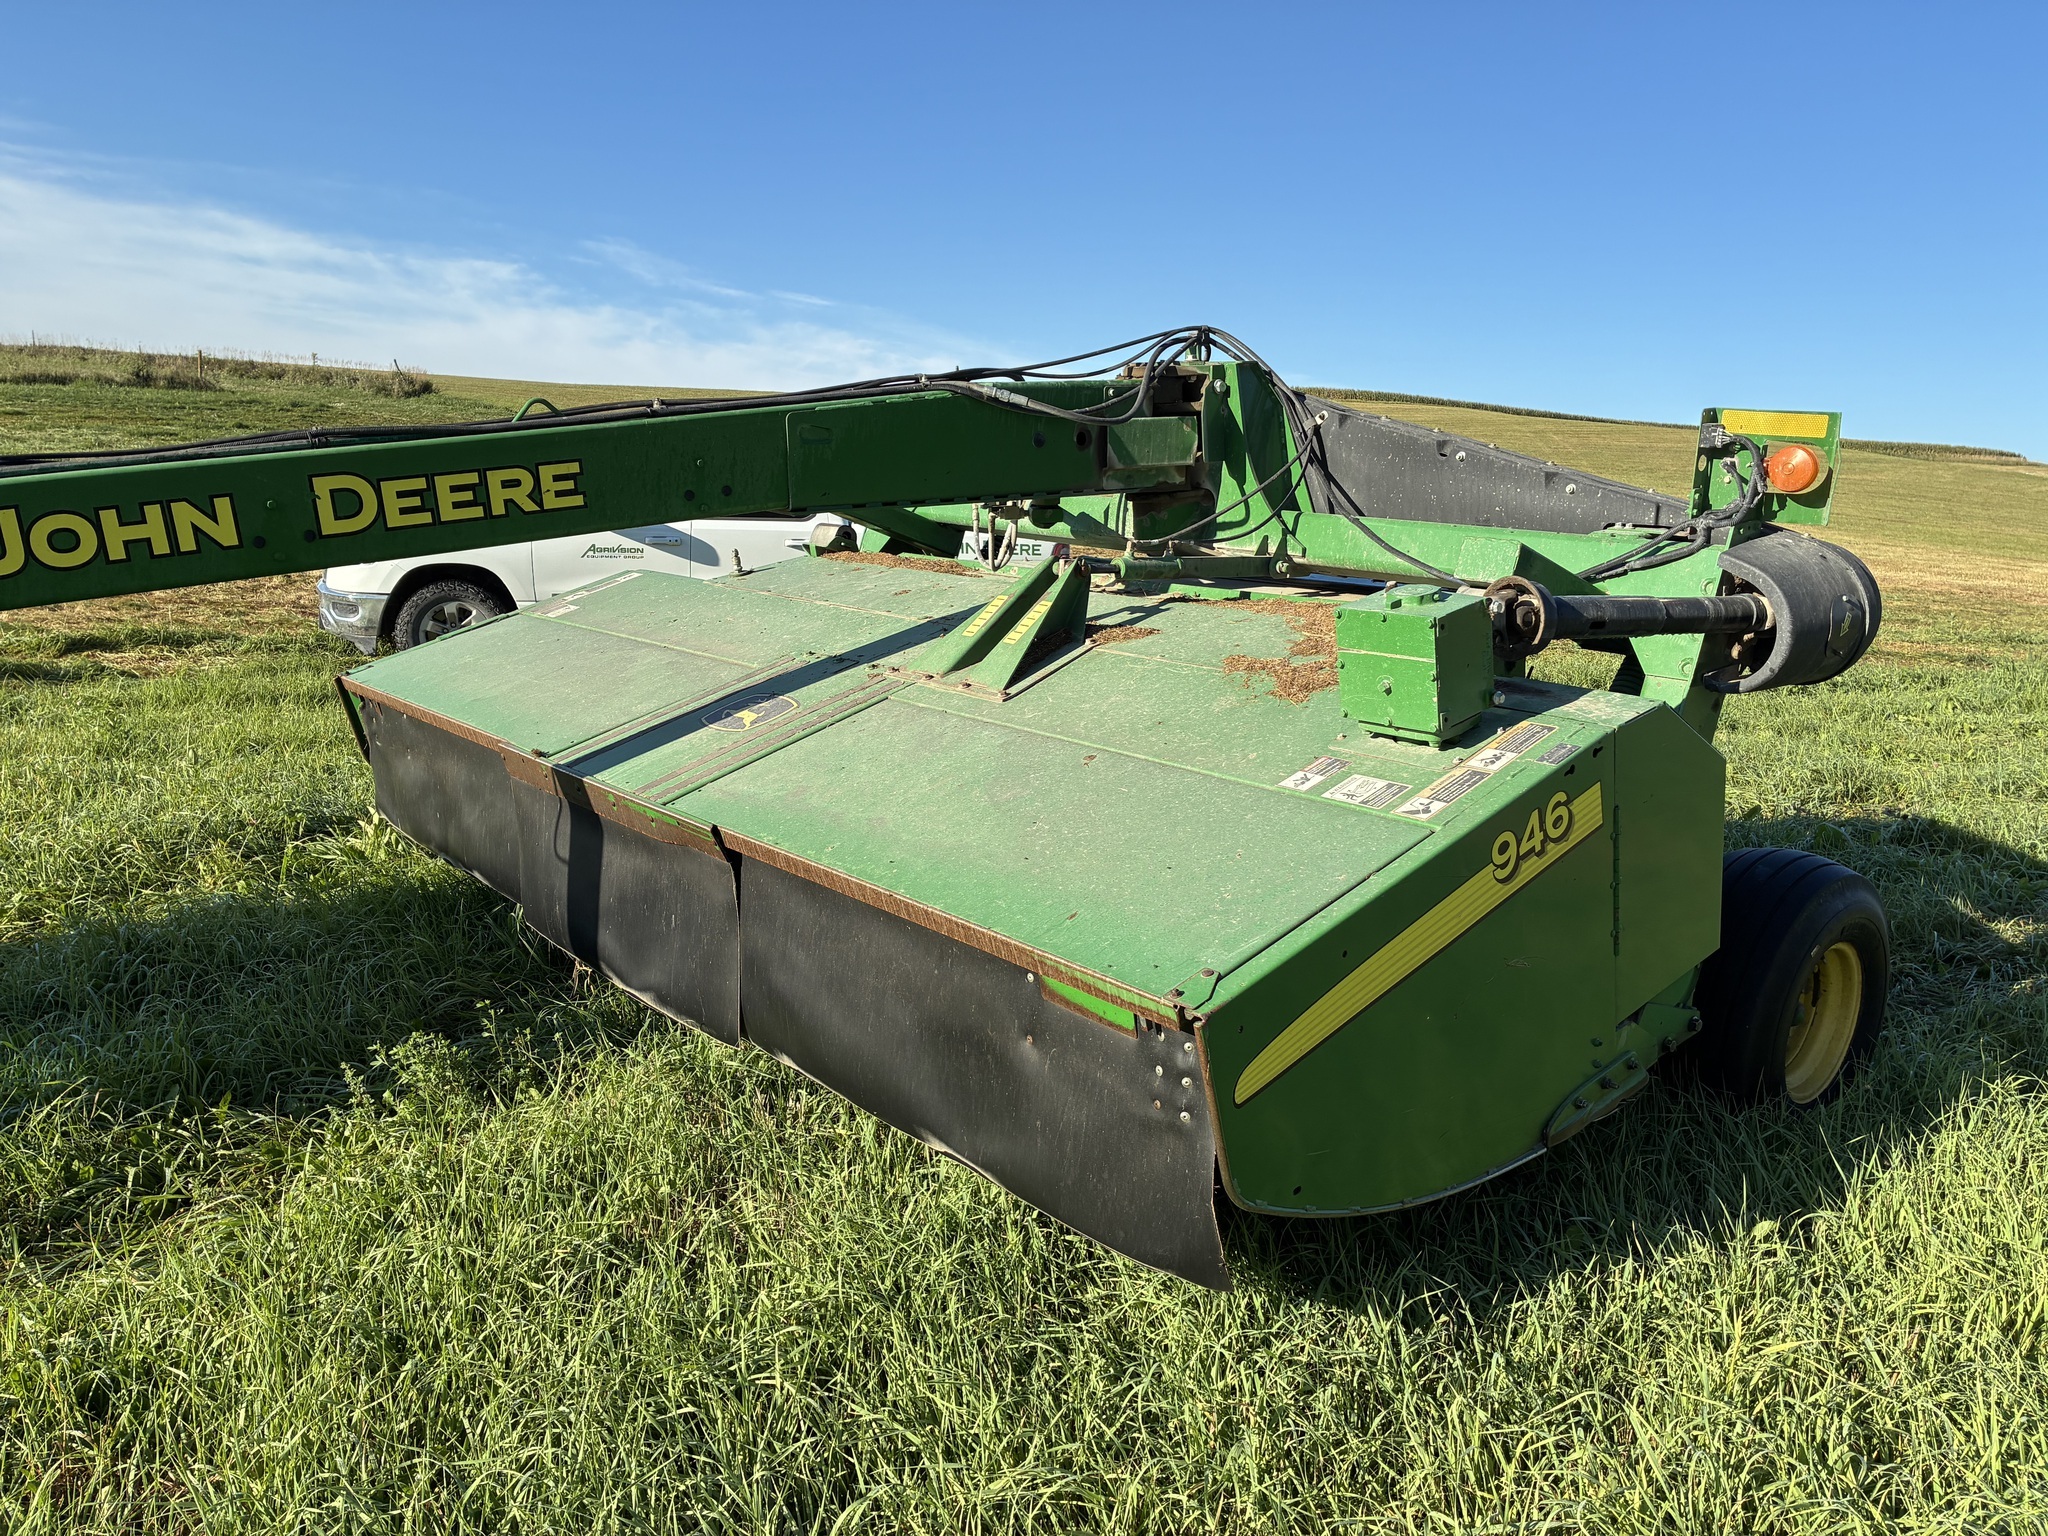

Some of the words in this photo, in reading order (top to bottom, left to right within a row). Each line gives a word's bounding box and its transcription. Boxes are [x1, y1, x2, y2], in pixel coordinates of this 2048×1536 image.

[0, 494, 242, 578] JOHN
[309, 460, 586, 538] DEERE
[1491, 791, 1572, 882] 946
